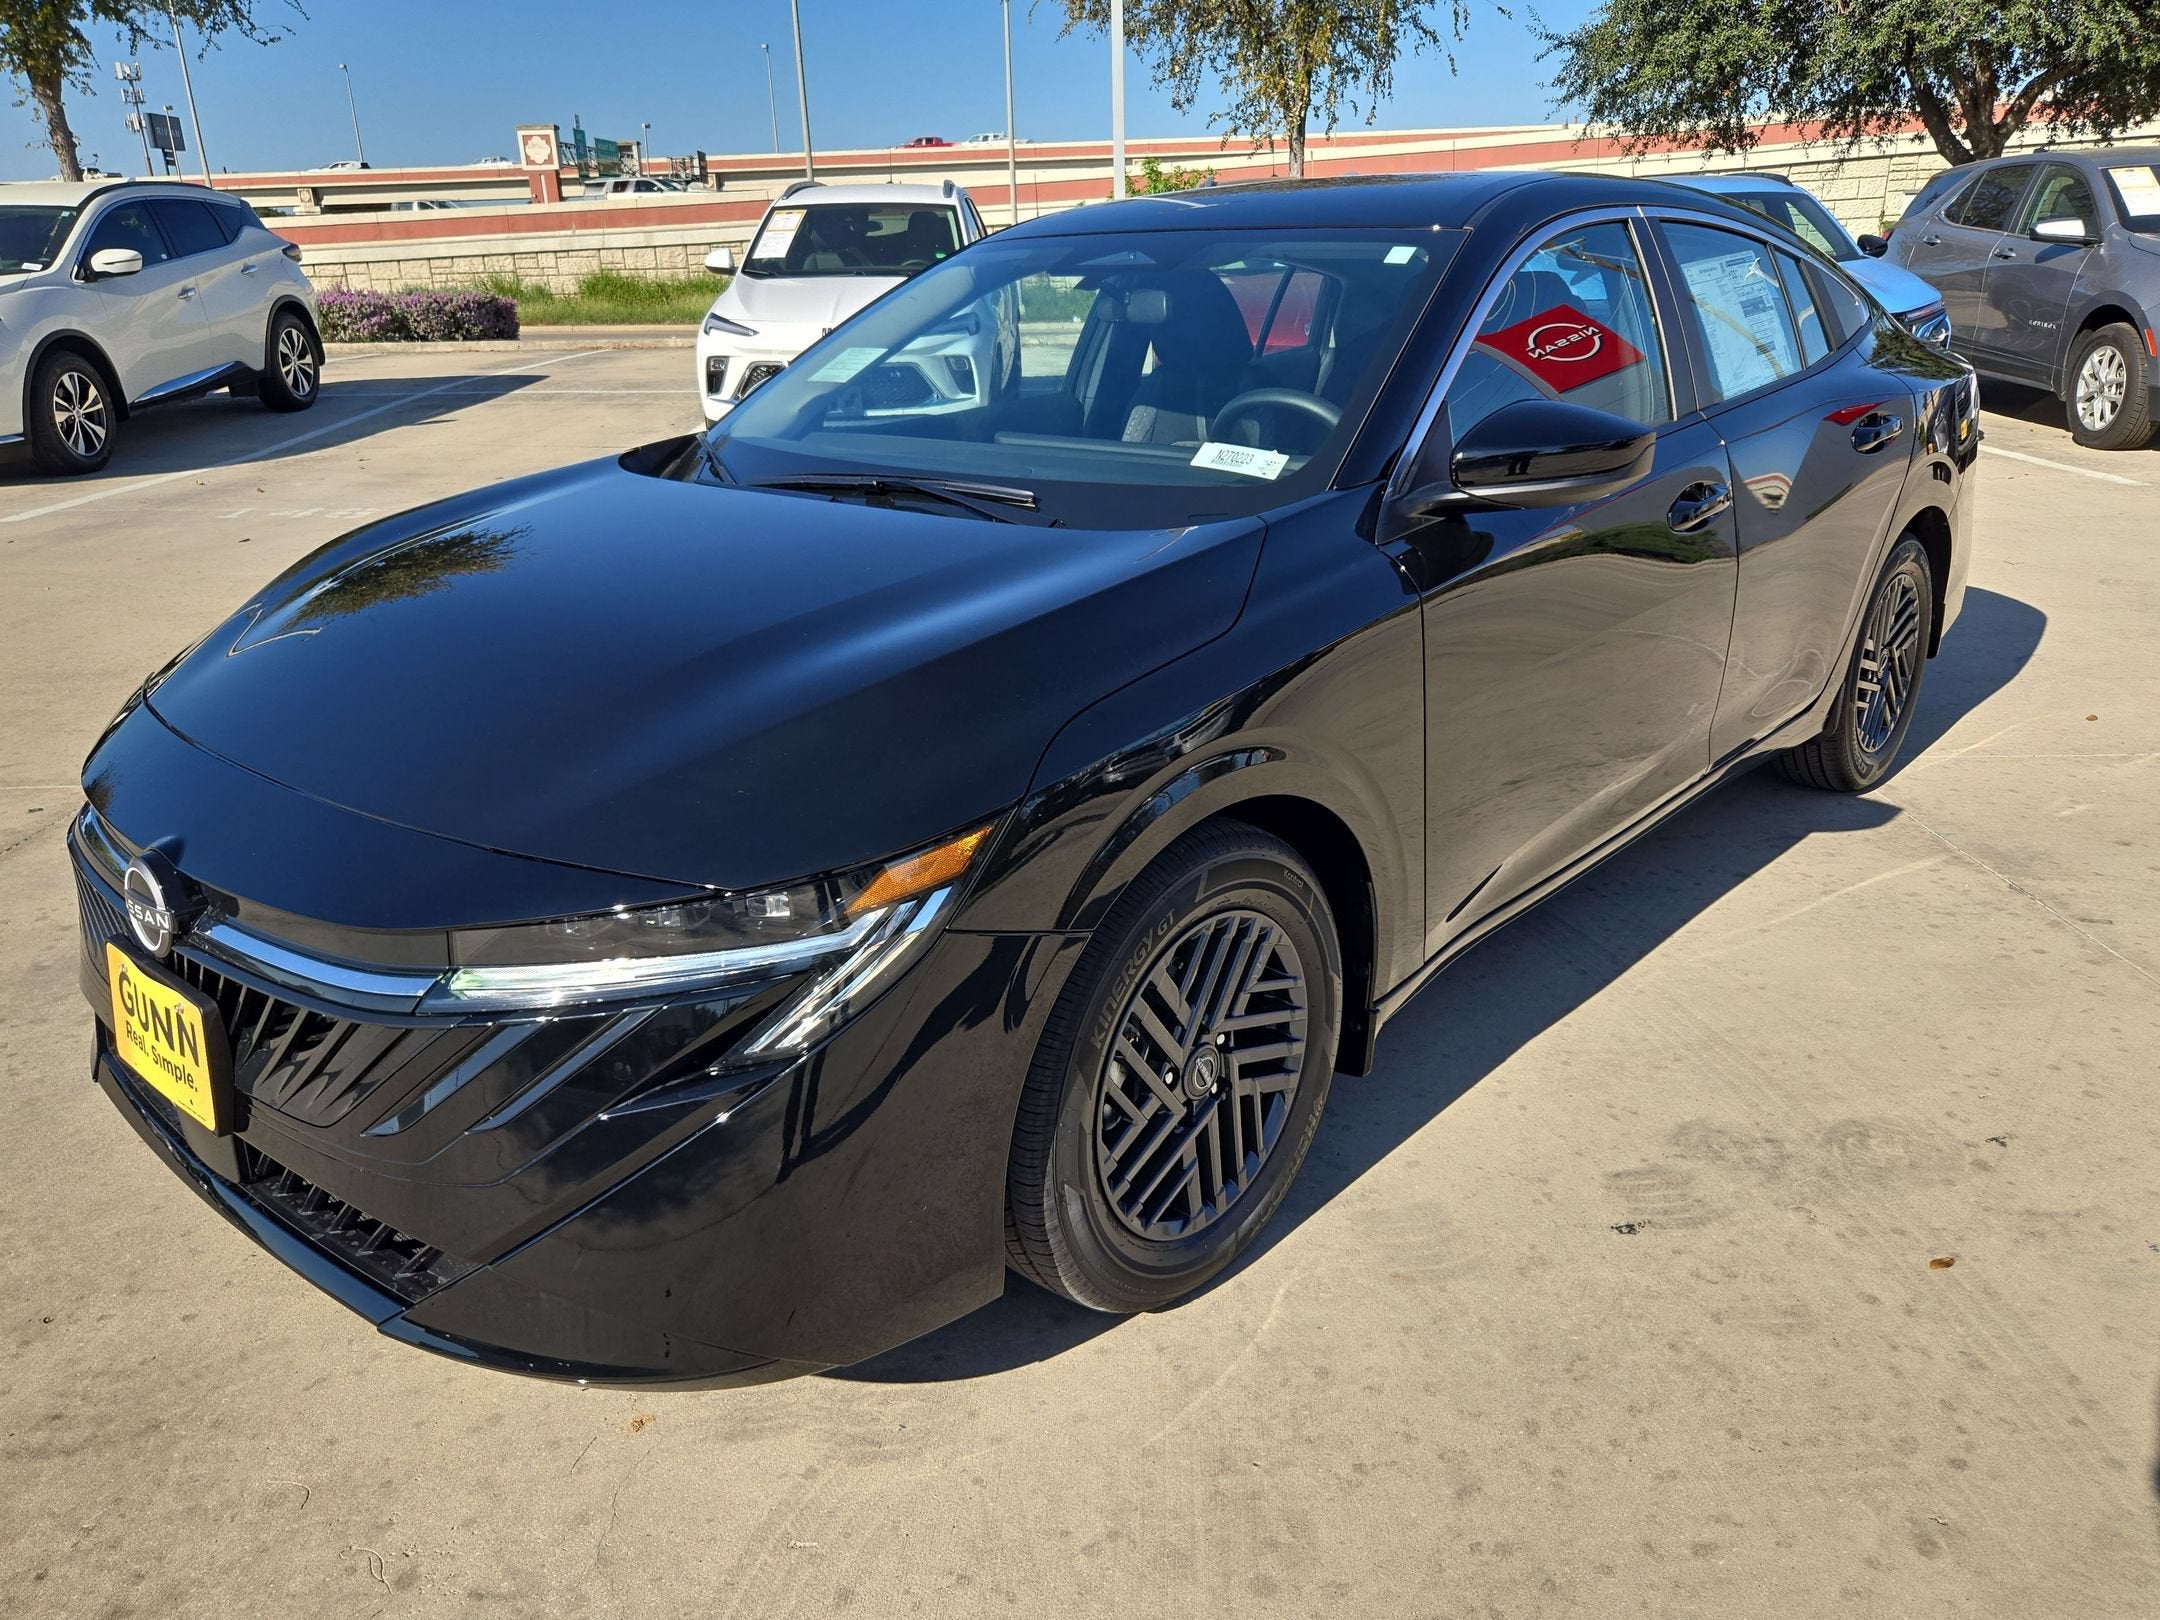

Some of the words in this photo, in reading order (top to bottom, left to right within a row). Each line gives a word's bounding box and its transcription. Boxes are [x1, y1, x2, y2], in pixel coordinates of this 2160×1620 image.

[157, 127, 181, 138] RIVAN
[127, 899, 170, 929] SSAN
[1090, 928, 1154, 1049] KINERGY
[1157, 908, 1176, 935] GT
[118, 971, 200, 1068] GUNN
[126, 1019, 149, 1057] Real.
[151, 1045, 198, 1092] Simple.
